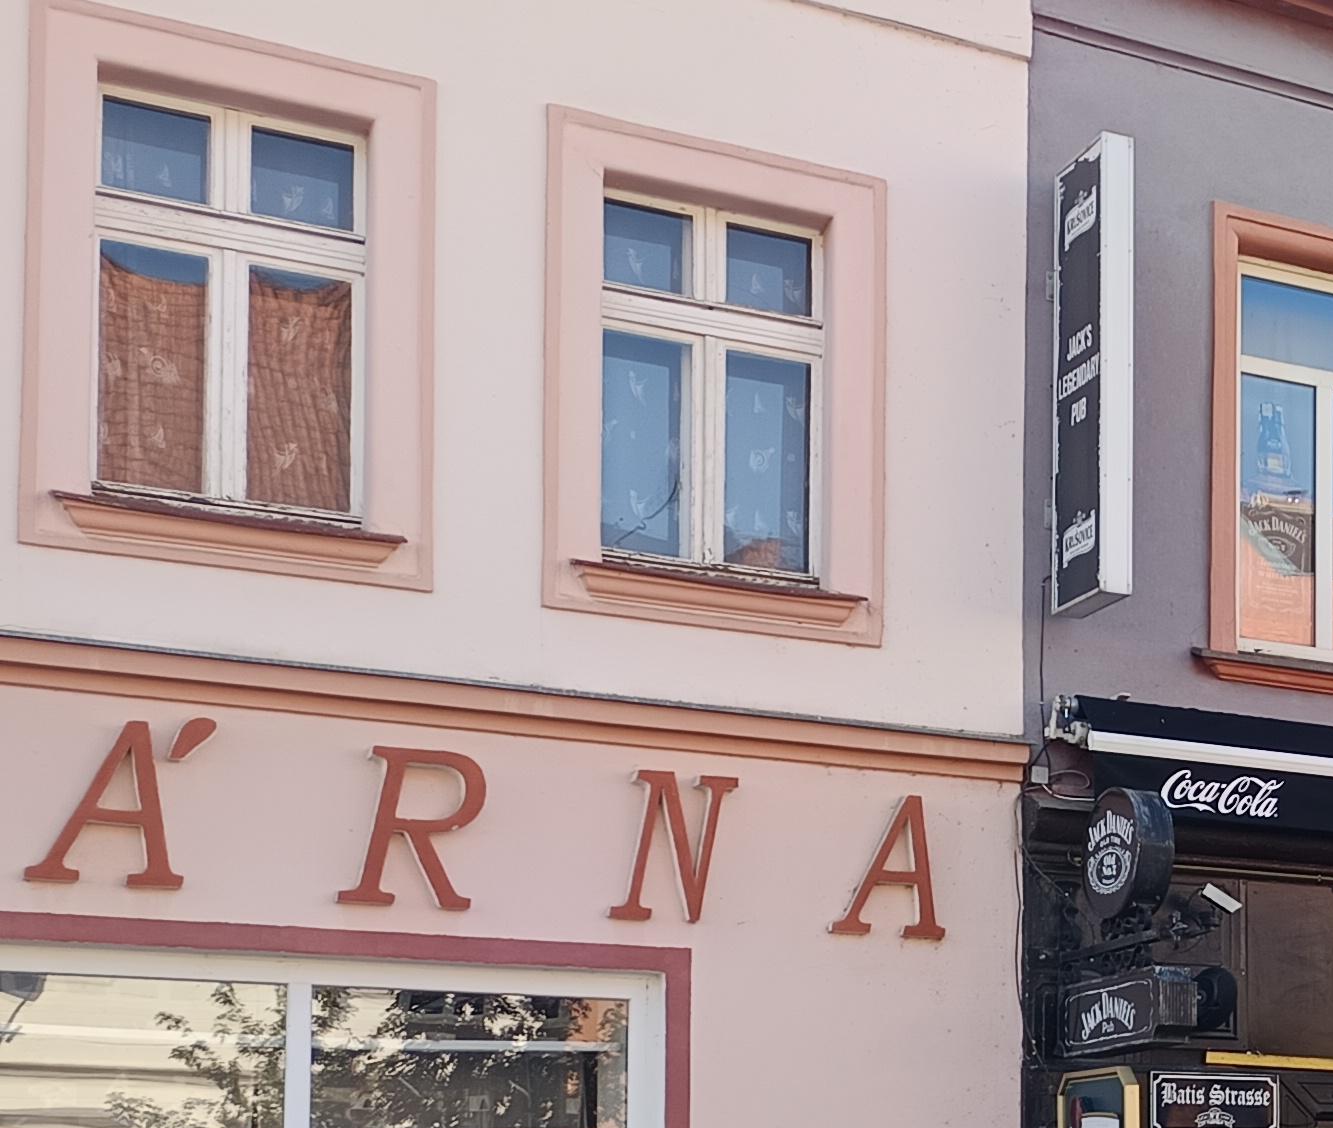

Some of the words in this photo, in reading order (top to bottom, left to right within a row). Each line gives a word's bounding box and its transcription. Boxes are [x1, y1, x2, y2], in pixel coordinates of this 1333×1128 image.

[1066, 323, 1092, 361] JACK'S
[1058, 352, 1100, 400] LEGENDARY
[1070, 396, 1087, 426] PUB
[1161, 769, 1285, 818] Coca-Cola
[23, 717, 946, 940] ÁRNA
[1081, 1000, 1103, 1040] JACK
[1101, 1020, 1115, 1034] Pub
[1161, 1082, 1205, 1107] Batis
[1209, 1083, 1271, 1106] Strasse
